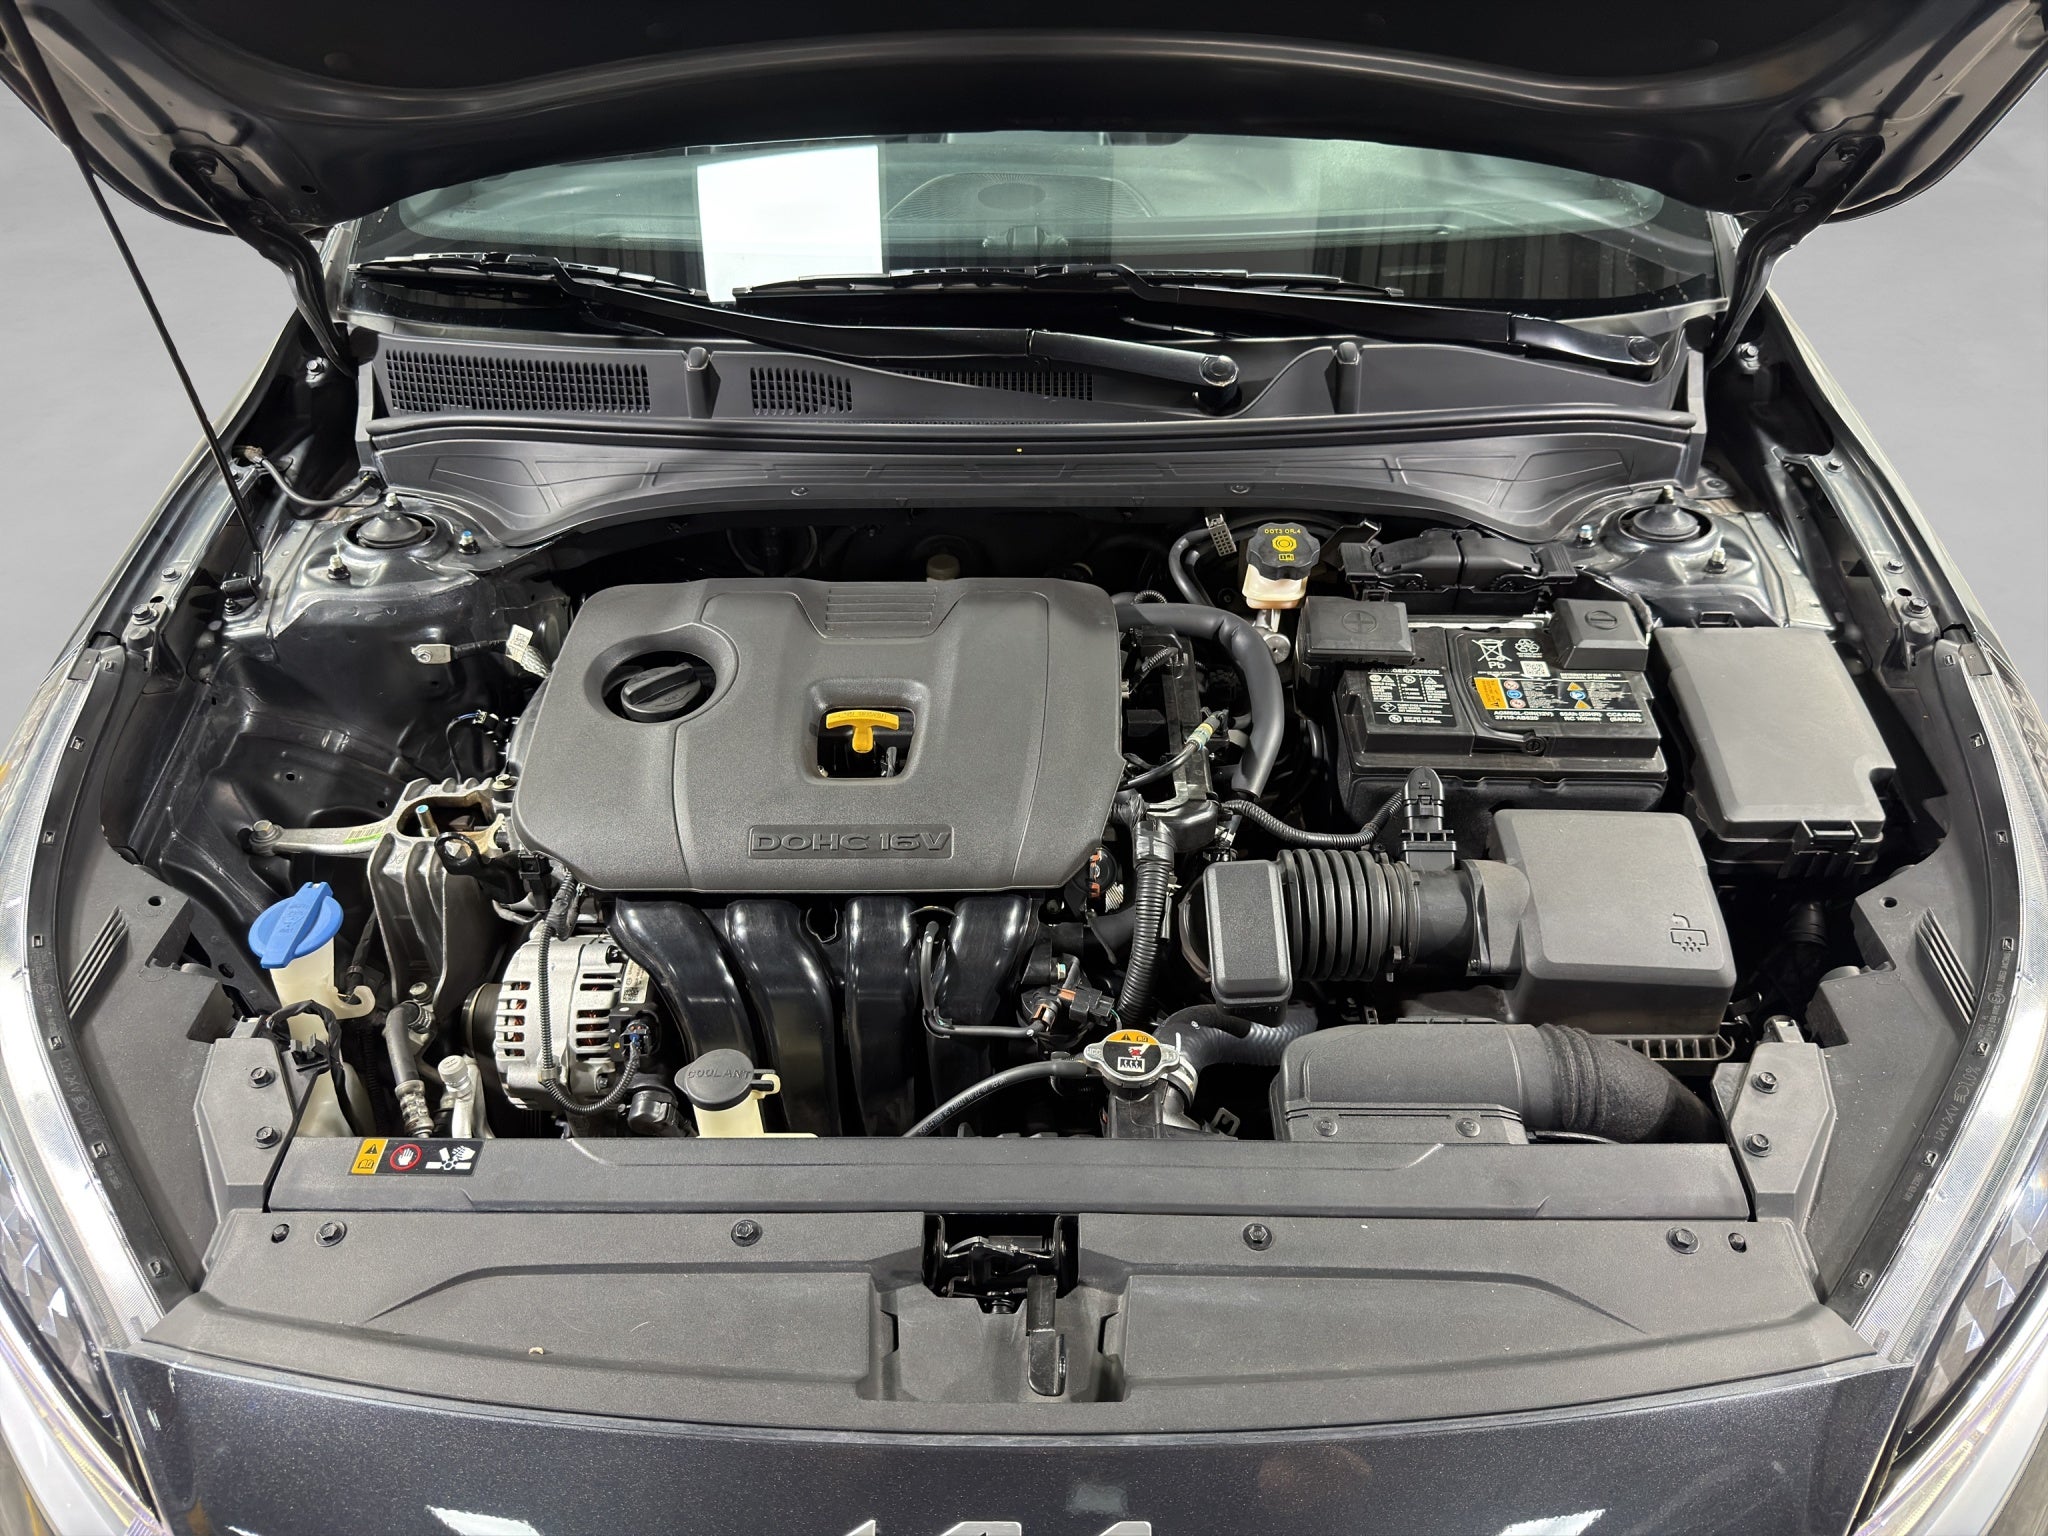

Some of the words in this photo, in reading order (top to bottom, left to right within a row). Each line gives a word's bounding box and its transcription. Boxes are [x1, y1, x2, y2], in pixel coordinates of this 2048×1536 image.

[1488, 661, 1506, 670] Pb
[751, 832, 871, 852] DOHC
[879, 832, 951, 852] 16V
[688, 1067, 752, 1081] COOLANT
